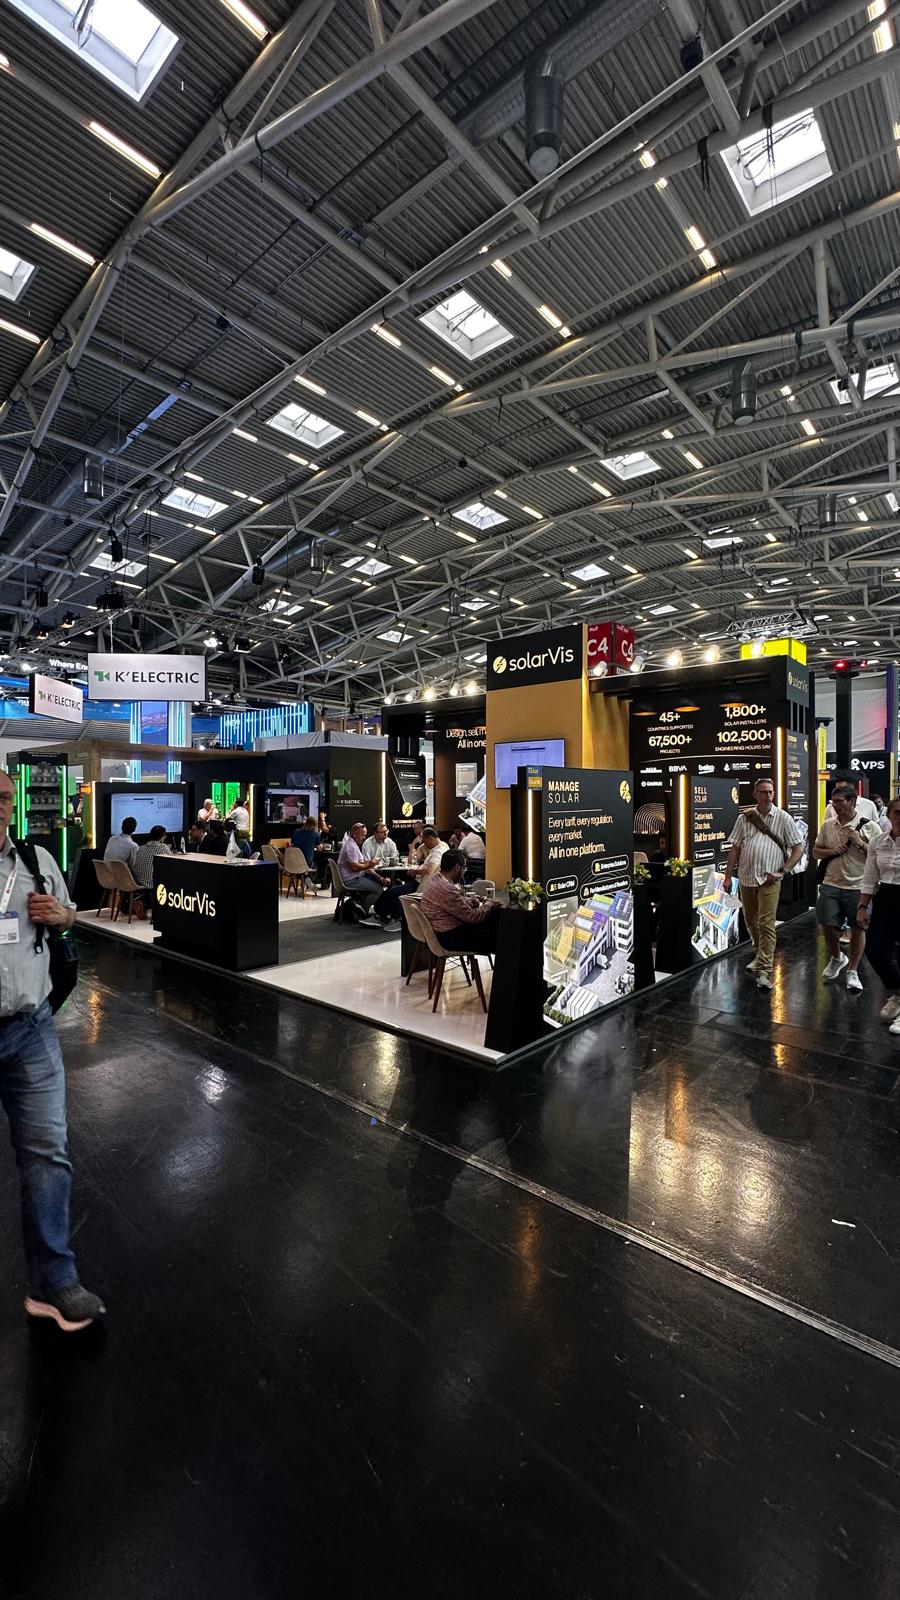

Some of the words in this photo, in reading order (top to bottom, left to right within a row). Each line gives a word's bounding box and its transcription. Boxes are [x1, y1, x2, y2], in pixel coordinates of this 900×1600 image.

[587, 637, 608, 656] C4
[621, 640, 634, 658] C4
[49, 659, 75, 669] Where
[509, 646, 574, 671] solarVis
[115, 671, 200, 684] K'ELECTRIC
[659, 711, 681, 723] 45+
[724, 704, 767, 719] 1,800+
[457, 740, 466, 749] All
[467, 740, 473, 748] in
[648, 734, 692, 747] 67,500+
[861, 761, 885, 770] VPS
[548, 781, 580, 792] MANAGE
[694, 786, 707, 795] SELL
[548, 792, 580, 803] SOLAR
[694, 795, 707, 803] SOLAR
[548, 817, 564, 829] Every
[577, 817, 591, 827] every
[548, 832, 564, 843] every
[548, 846, 558, 860] All
[559, 846, 565, 858] in
[566, 846, 579, 858] one
[579, 842, 606, 858] platform.
[168, 888, 216, 917] solarVis
